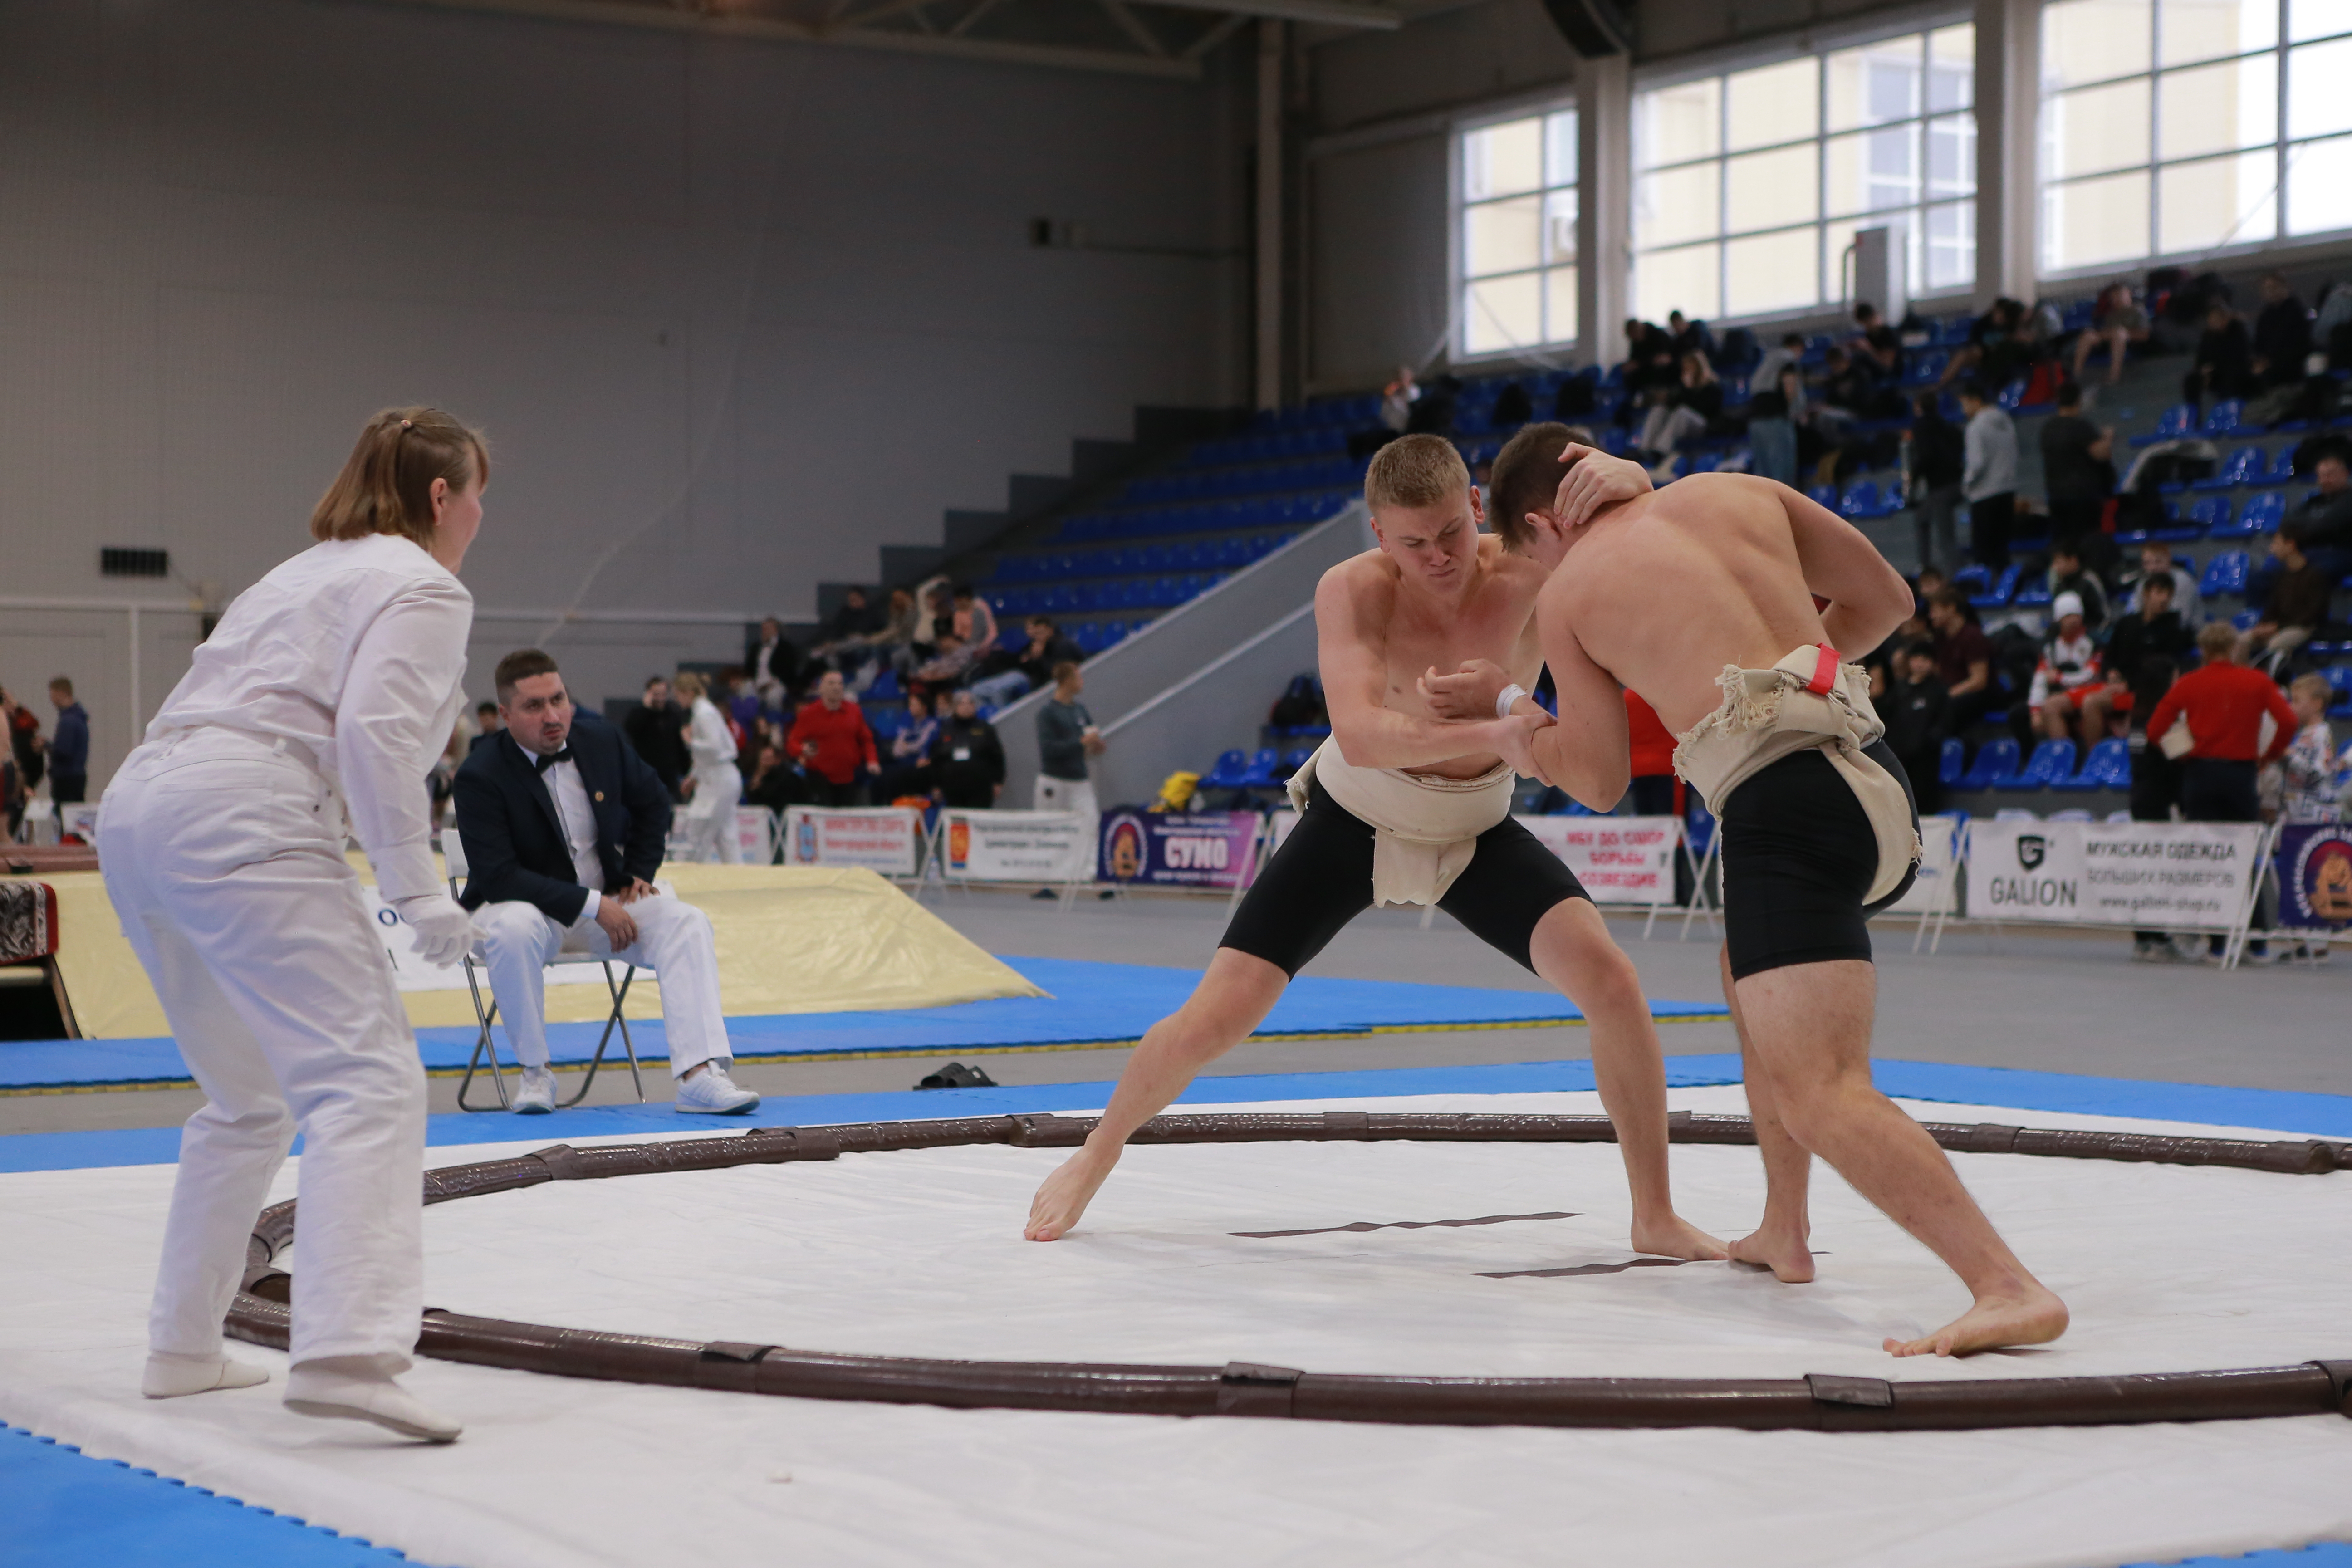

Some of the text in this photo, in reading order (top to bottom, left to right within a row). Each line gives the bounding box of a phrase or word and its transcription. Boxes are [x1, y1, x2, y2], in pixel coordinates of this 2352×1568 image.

[1598, 832, 1620, 846] ДО
[1165, 837, 1229, 869] СУМО
[1589, 851, 1646, 865] БОРЬБЫ
[2087, 842, 2237, 860] МУЖСКАЯ ОДЕЖДА
[2087, 868, 2236, 888] БОЛЬШИХ РАЗМЕРОВ
[1990, 877, 2076, 906] GALION
